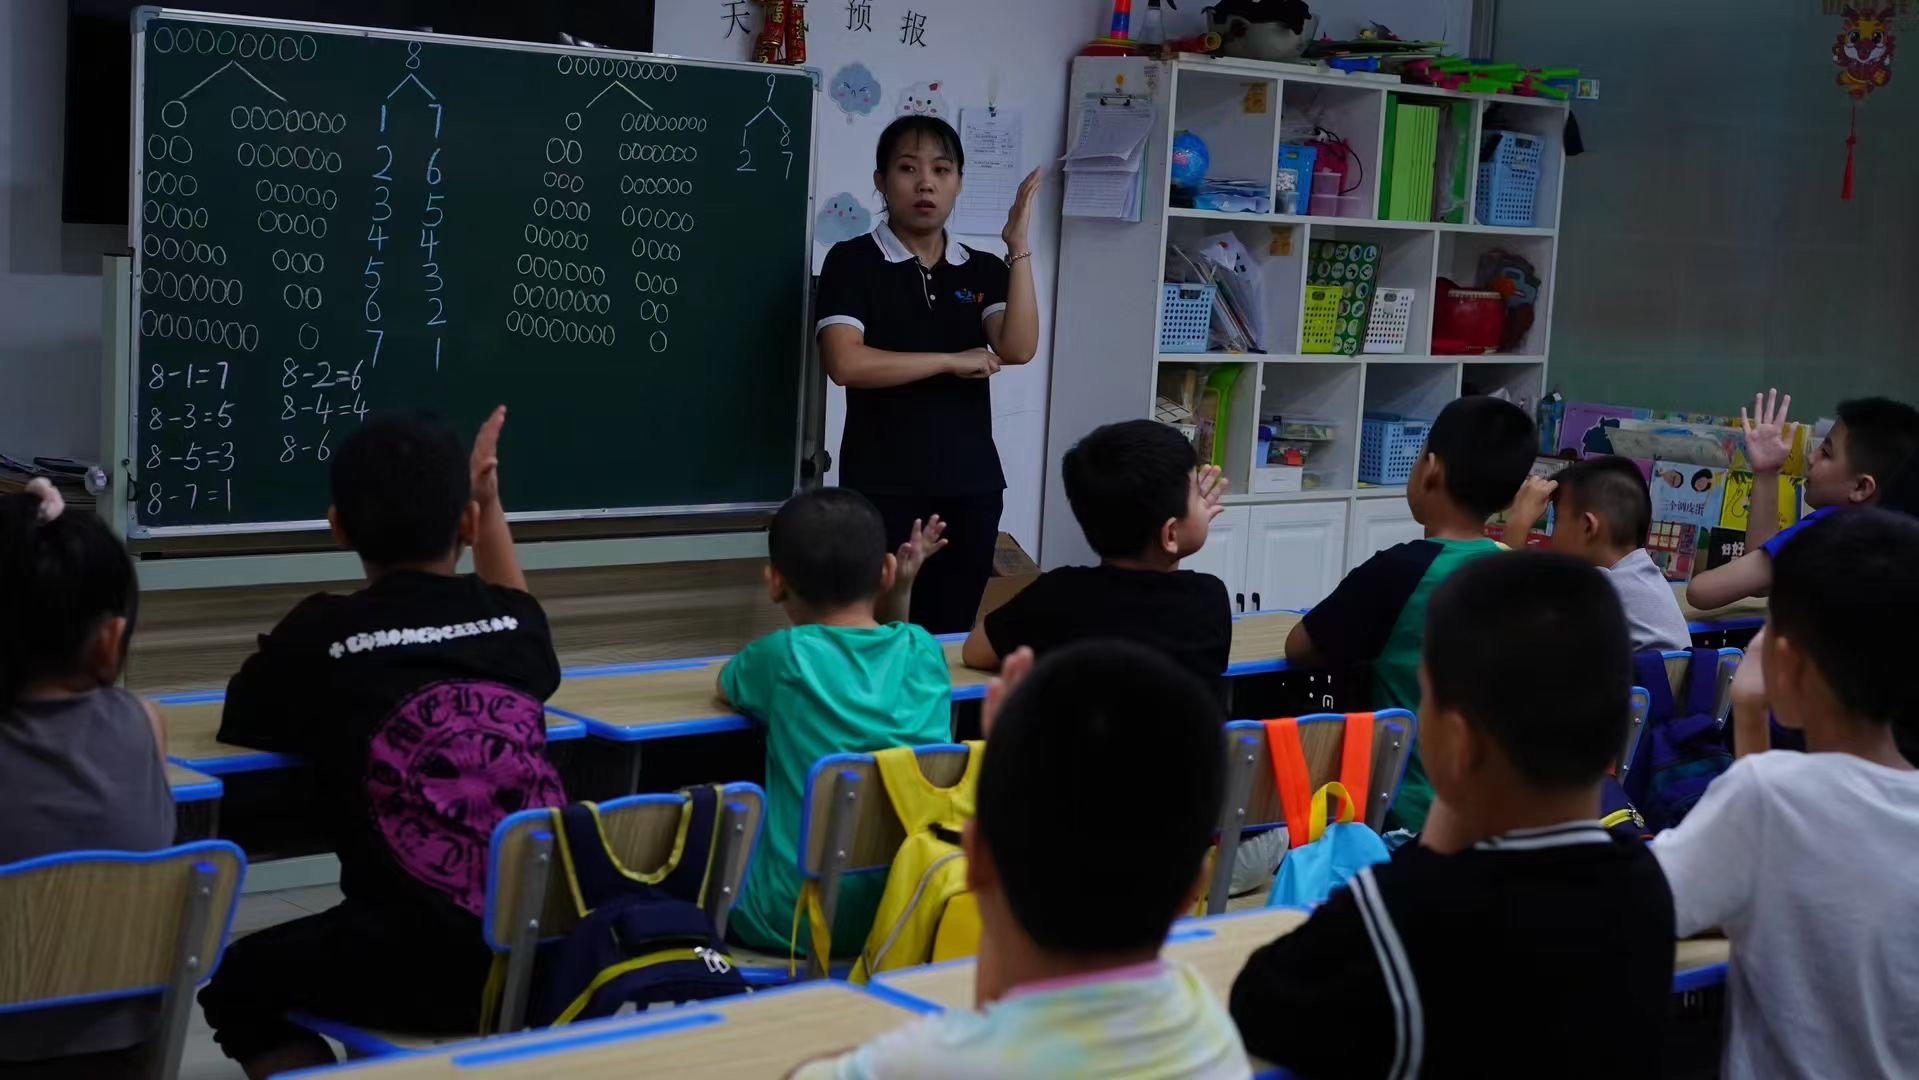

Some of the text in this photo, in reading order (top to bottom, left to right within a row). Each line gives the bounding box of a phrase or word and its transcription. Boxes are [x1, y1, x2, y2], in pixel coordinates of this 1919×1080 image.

[405, 40, 422, 69] 8
[766, 74, 776, 103] 9
[429, 104, 442, 138] 7
[780, 125, 791, 146] 8
[373, 145, 392, 180] 2
[427, 148, 441, 184] 6
[737, 149, 756, 171] 2
[782, 152, 793, 179] 7
[372, 186, 391, 221] 3
[423, 193, 444, 227] 5
[368, 224, 389, 251] 4
[421, 229, 439, 261] 4
[365, 256, 384, 288] 5
[423, 263, 443, 291] 3
[366, 288, 381, 321] 6
[427, 298, 446, 325] 2
[367, 330, 383, 368] 7
[149, 362, 228, 389] 8-1=7
[282, 358, 363, 390] 8-2=6
[149, 400, 234, 430] 8-3=5
[282, 393, 369, 424] 8-4=4
[147, 442, 234, 471] 8-5=3
[148, 479, 230, 515] 8-7=1
